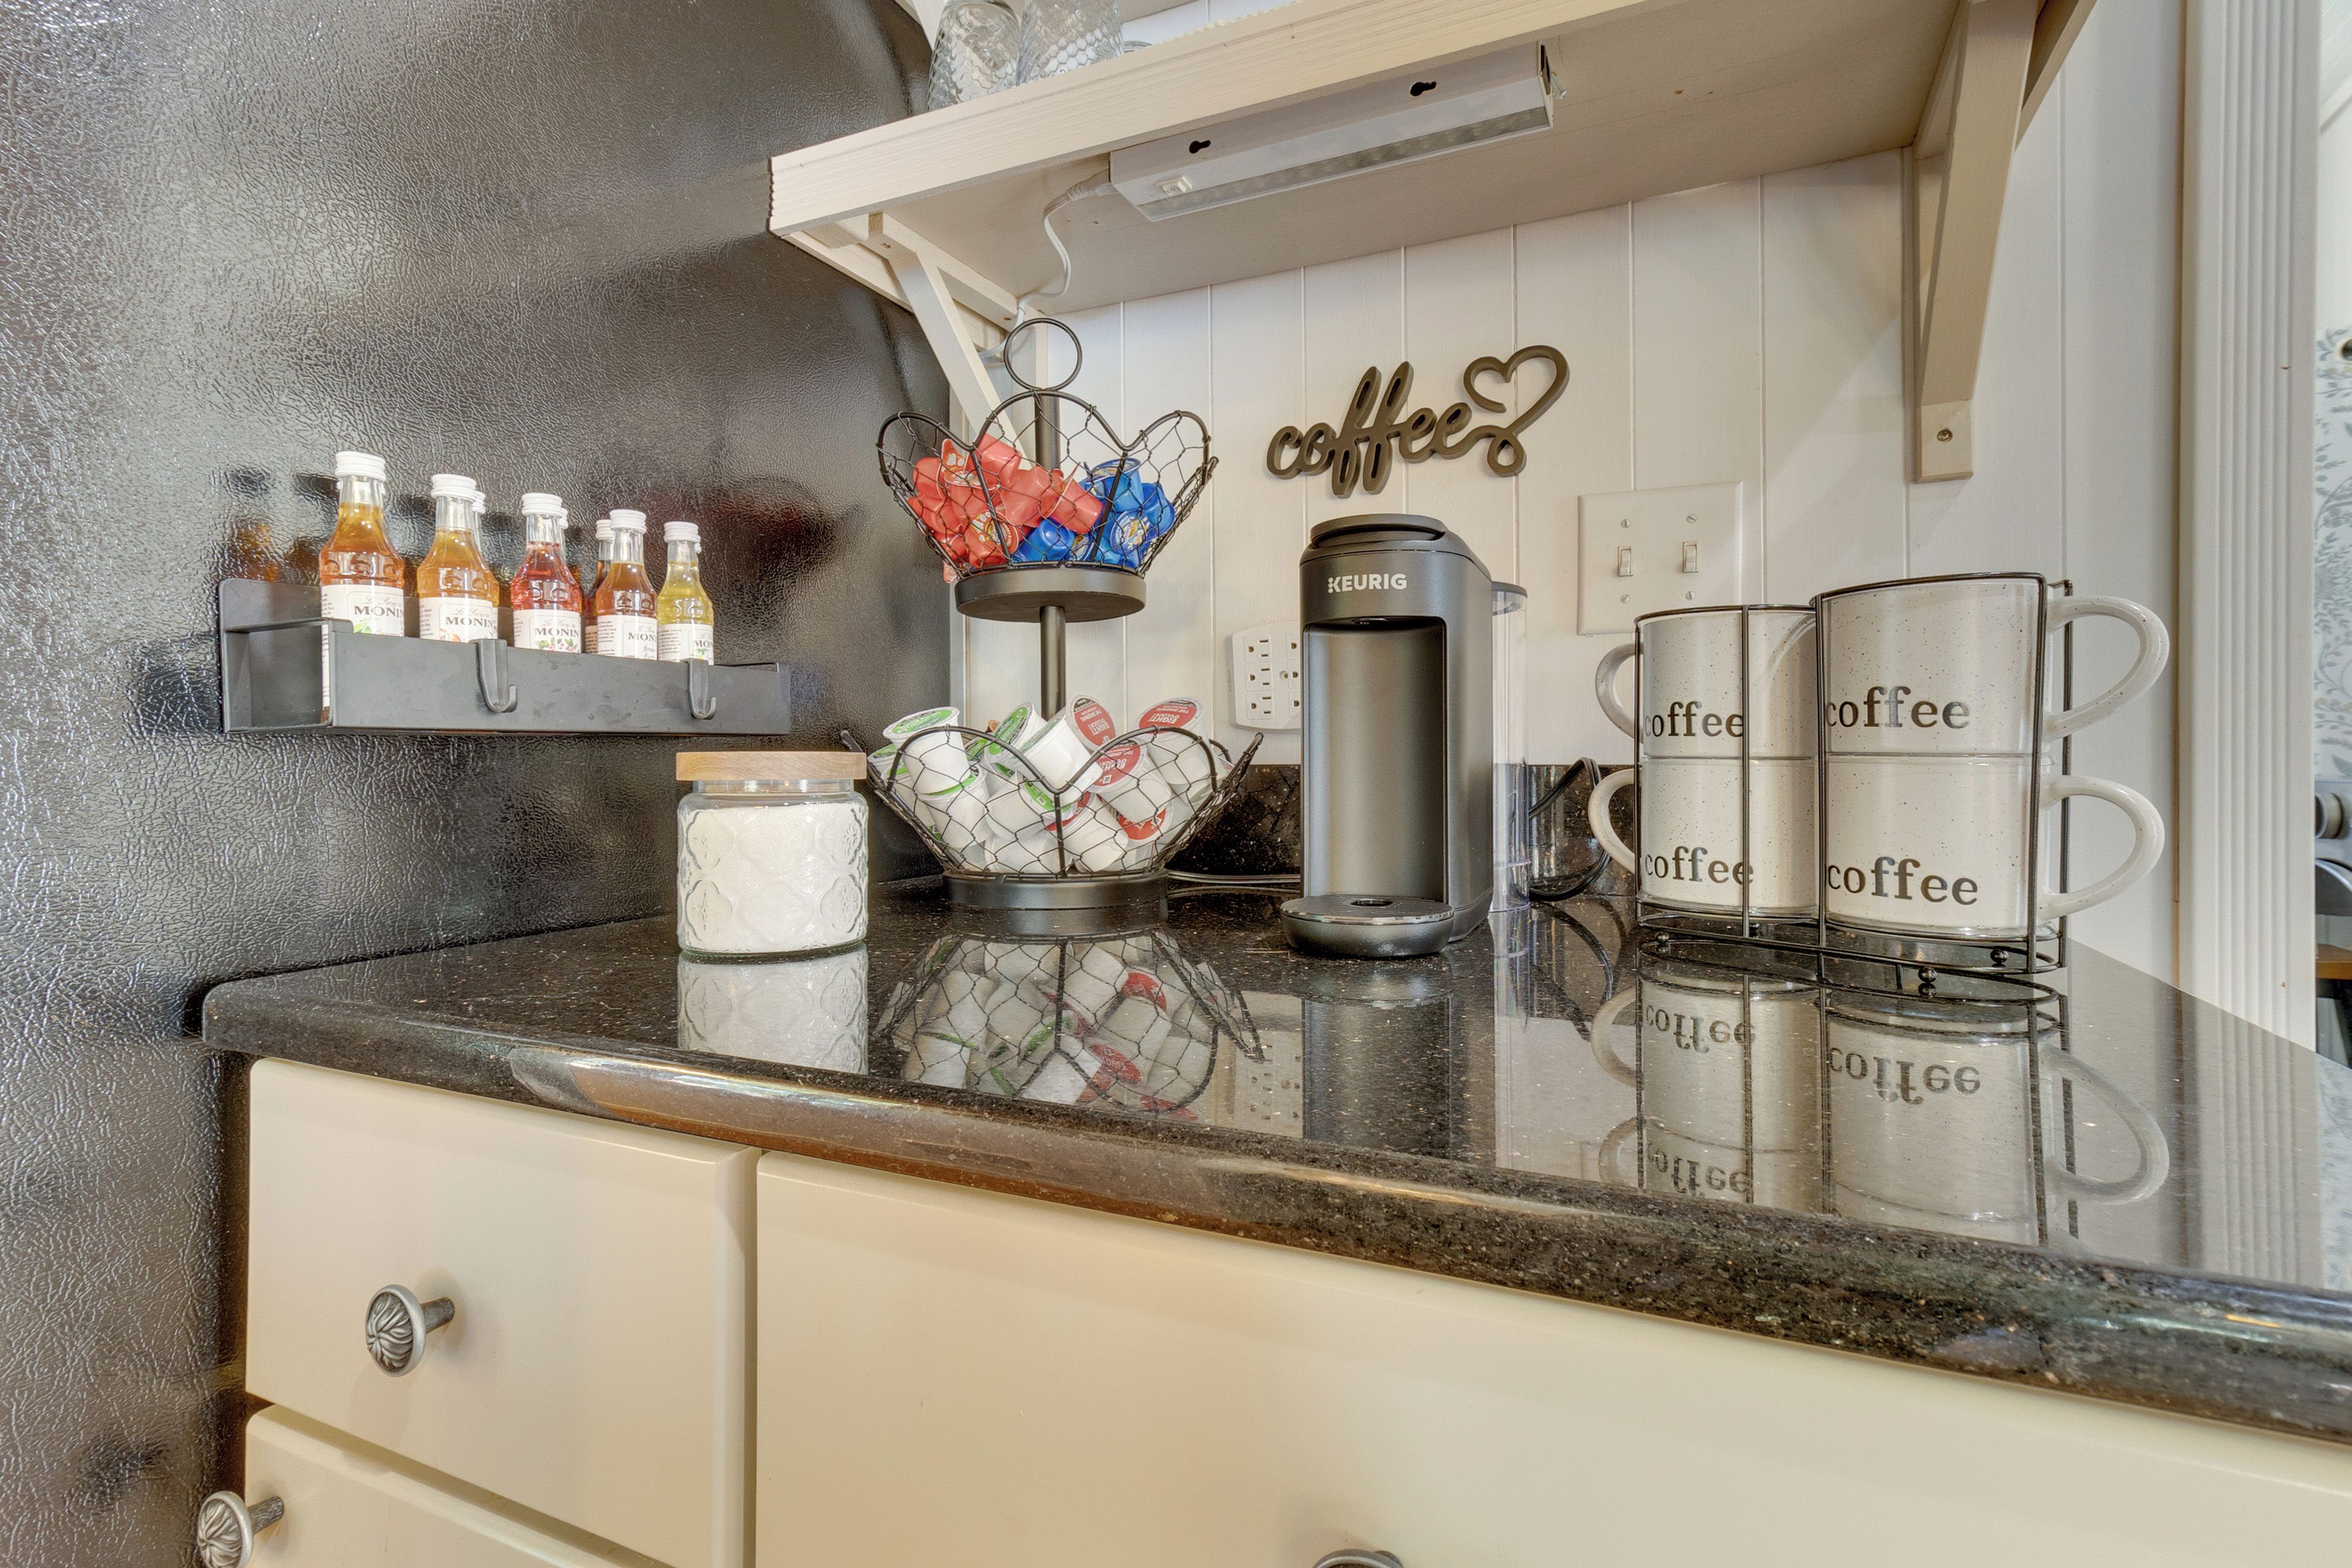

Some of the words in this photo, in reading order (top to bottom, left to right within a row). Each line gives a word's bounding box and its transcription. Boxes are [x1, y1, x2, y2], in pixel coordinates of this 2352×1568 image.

[1267, 361, 1472, 499] coffee
[1327, 573, 1408, 594] KEURIG
[534, 627, 579, 638] MONIN
[1645, 701, 1743, 737] coffee
[1825, 686, 1969, 729] coffee
[1645, 846, 1754, 885] coffee
[1828, 856, 1978, 905] coffee
